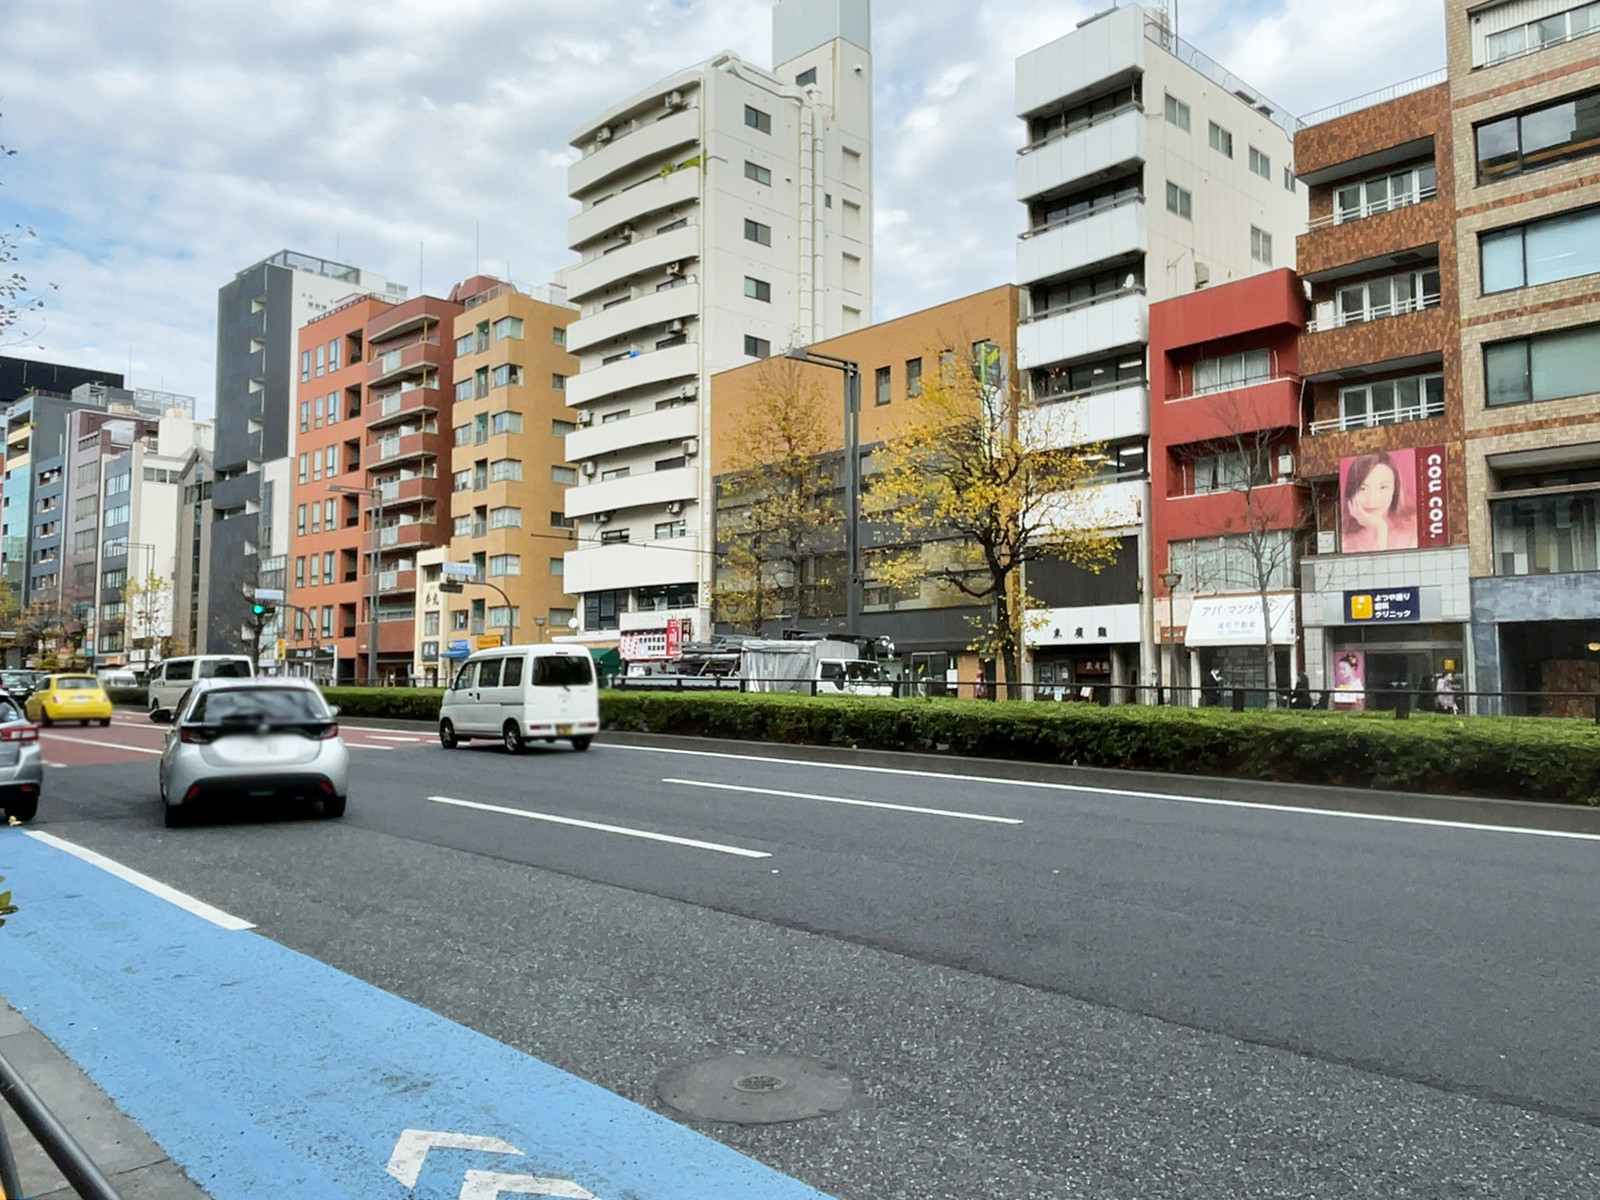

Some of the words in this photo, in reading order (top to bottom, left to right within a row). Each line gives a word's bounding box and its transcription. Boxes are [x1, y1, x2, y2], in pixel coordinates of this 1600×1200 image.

[1427, 453, 1442, 493] cou
[1374, 610, 1411, 619] クリニック
